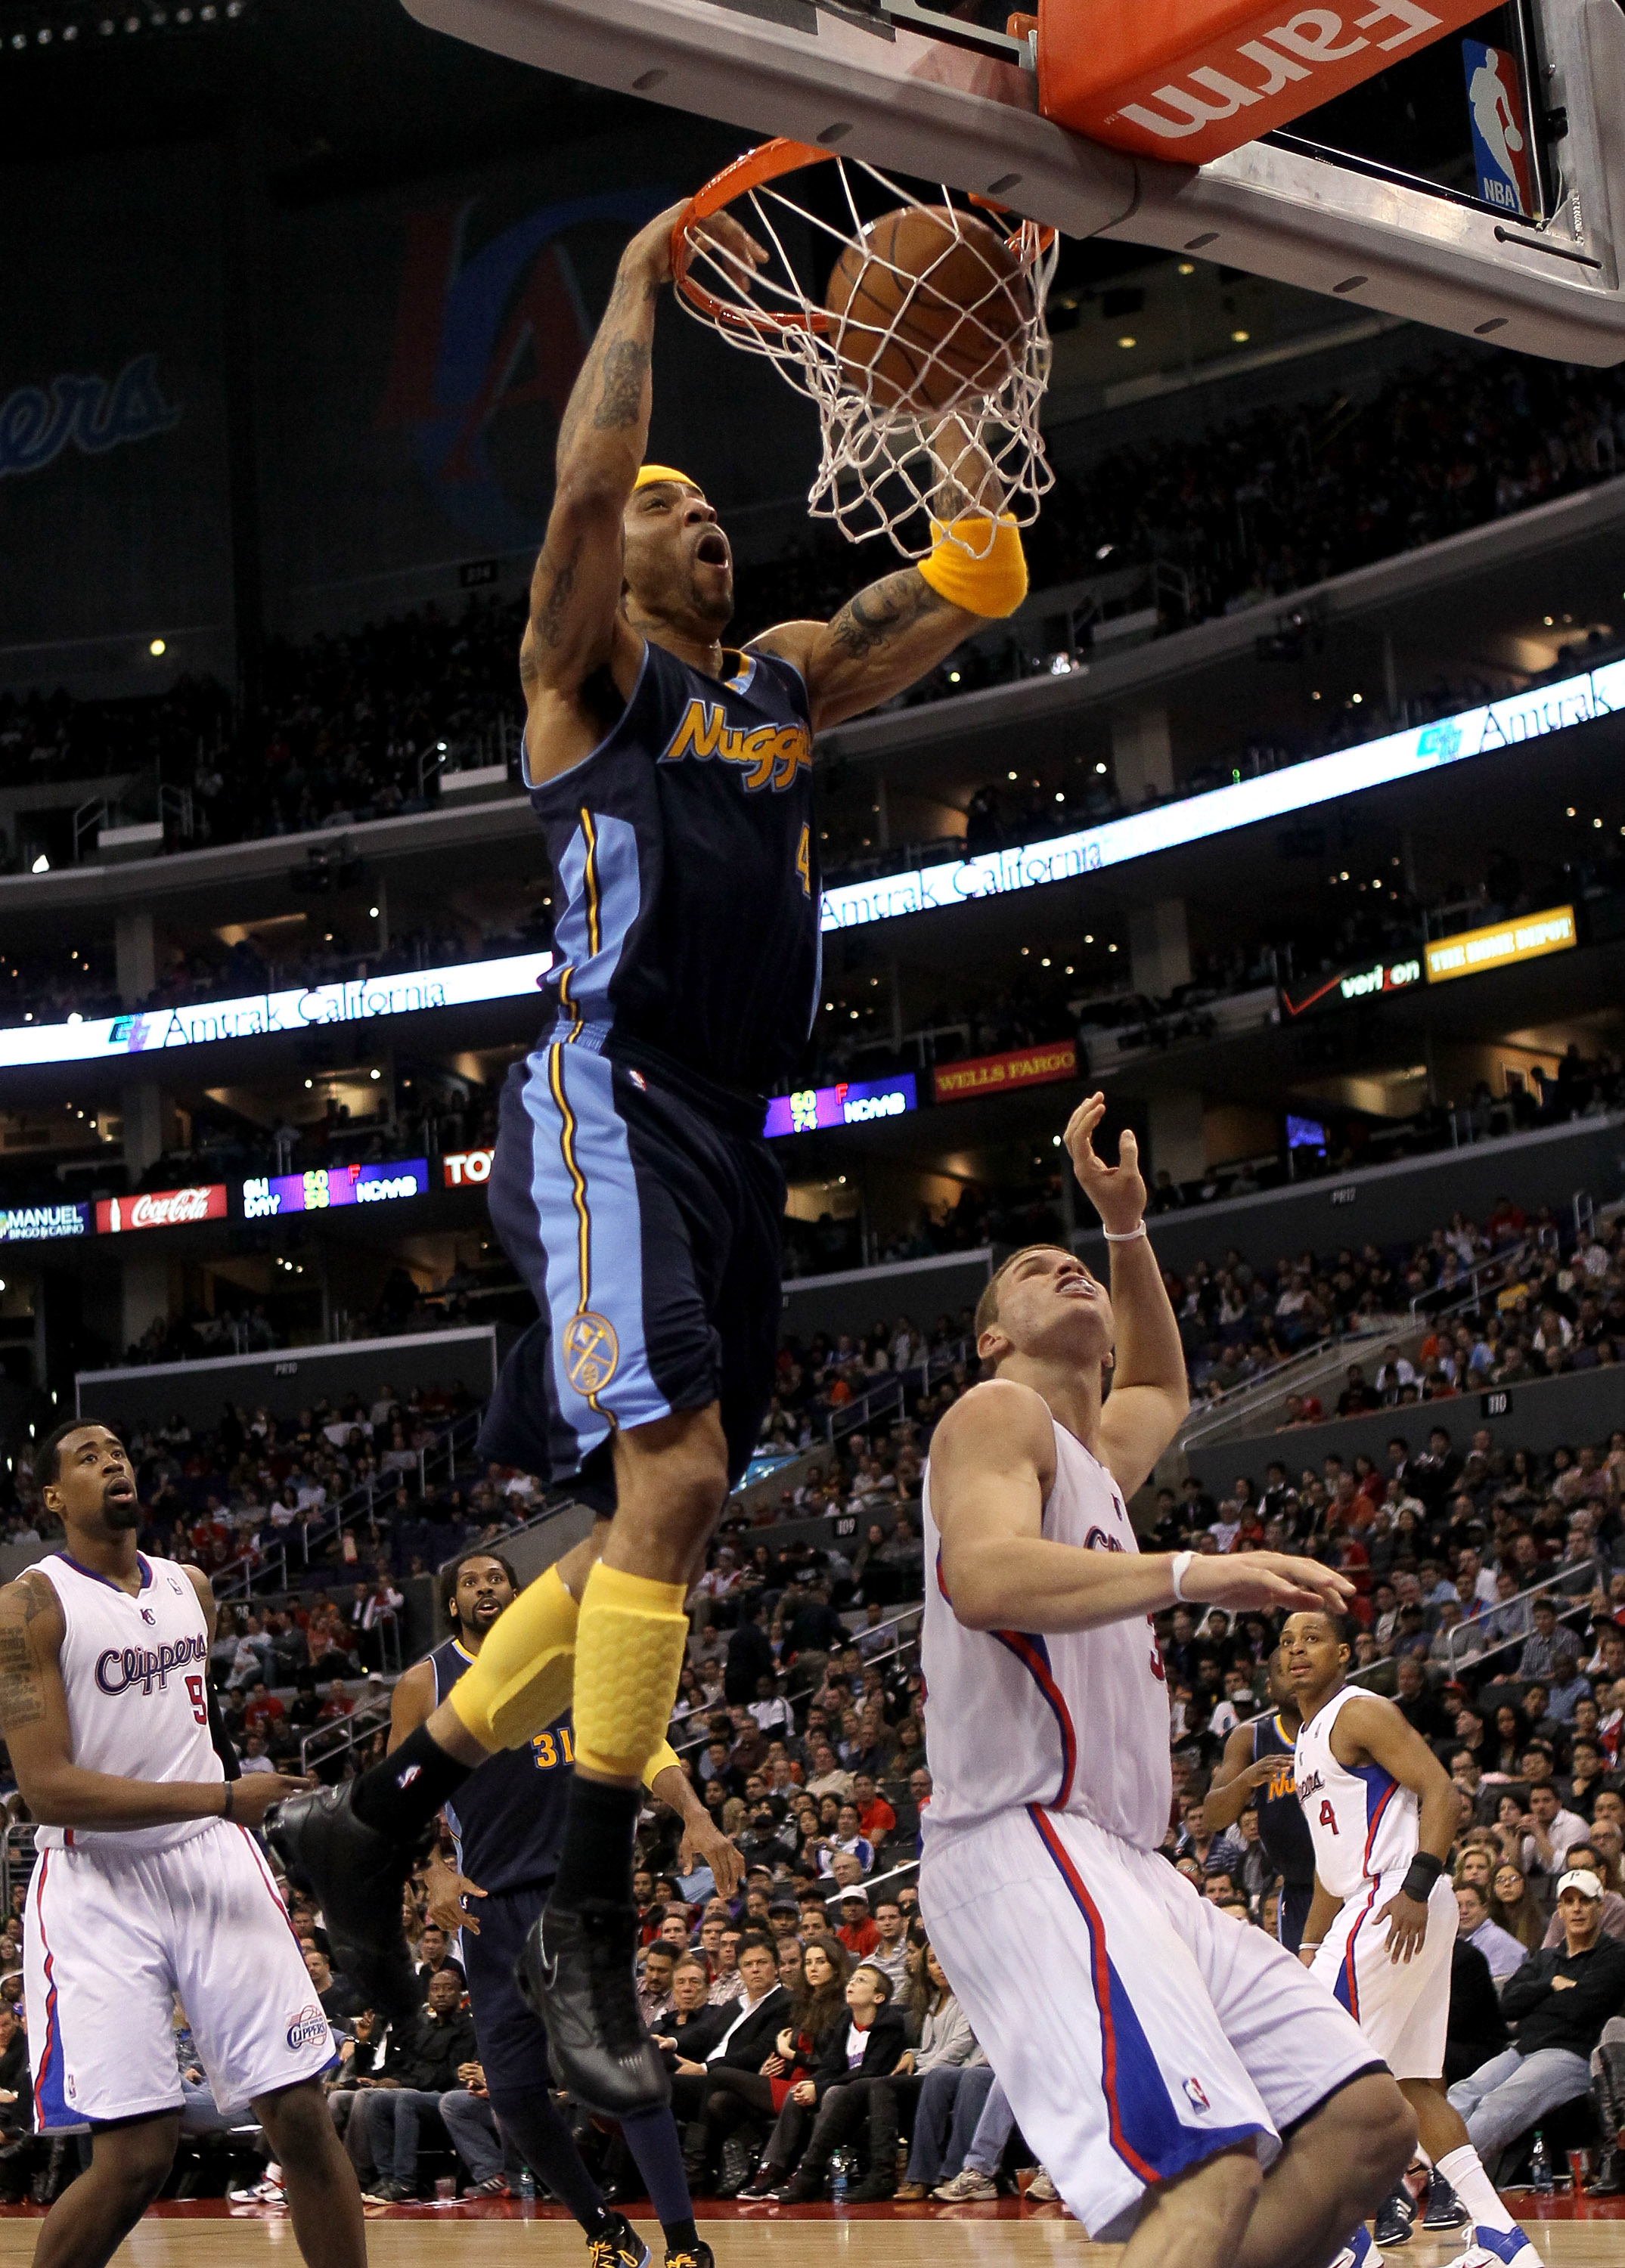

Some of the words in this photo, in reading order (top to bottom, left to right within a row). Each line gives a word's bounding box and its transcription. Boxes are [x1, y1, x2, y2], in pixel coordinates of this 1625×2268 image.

[1483, 177, 1516, 209] NBA
[1478, 673, 1615, 754] Amtrak
[952, 841, 1104, 899] California
[164, 1007, 281, 1048] Amtrak
[298, 979, 447, 1027] California
[938, 1064, 1004, 1090] WELLS
[1008, 1051, 1075, 1078] FARGO
[789, 1089, 817, 1113] 60
[836, 1083, 848, 1105] F
[843, 1092, 906, 1123] NCAAB
[792, 1111, 817, 1132] 74
[444, 1149, 495, 1185] TO
[8, 1205, 83, 1229] MANUEL
[243, 1194, 281, 1219] DAY
[1488, 1392, 1507, 1414] 110
[836, 1518, 855, 1535] 109
[95, 1633, 207, 1696] Clippers
[185, 1675, 207, 1725] 9
[530, 1727, 575, 1770] 31
[1320, 1799, 1340, 1835] 4
[287, 2022, 326, 2050] CLIPPERS
